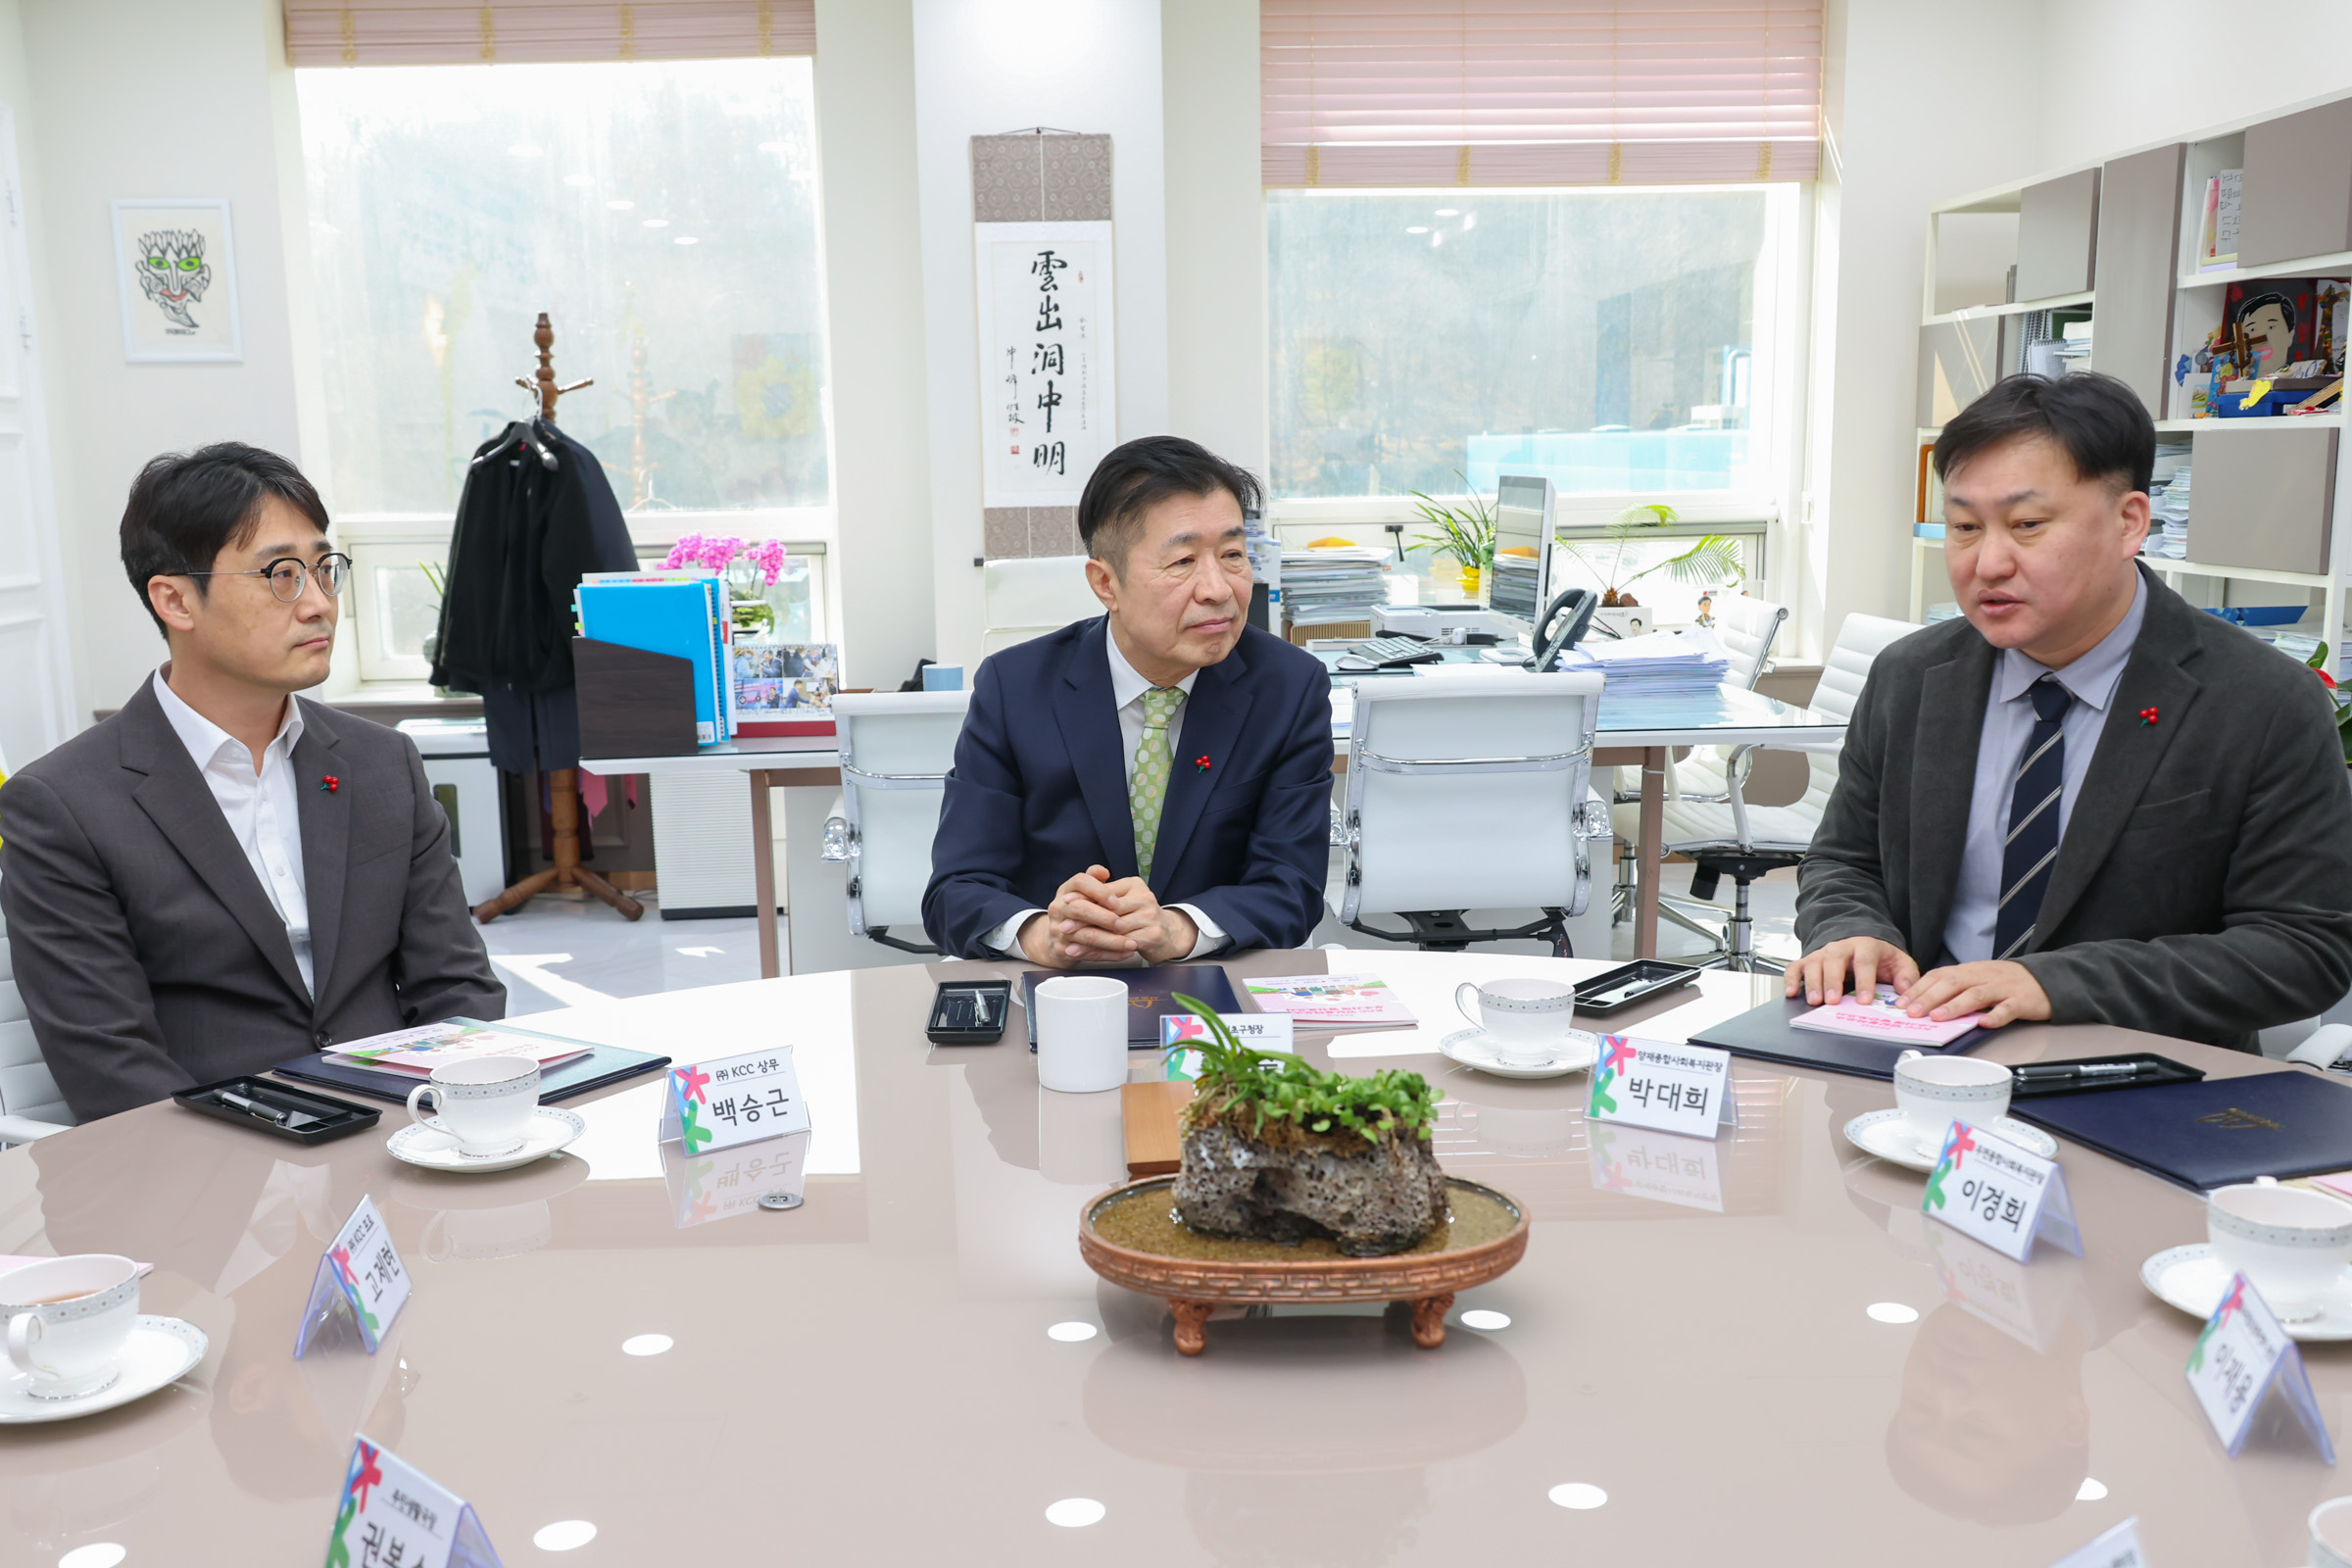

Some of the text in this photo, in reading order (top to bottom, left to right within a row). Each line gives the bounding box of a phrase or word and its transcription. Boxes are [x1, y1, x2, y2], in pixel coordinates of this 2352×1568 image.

[1031, 250, 1067, 476] 雲出洞中明
[731, 1063, 755, 1078] KCC
[758, 1058, 780, 1074] 상무
[1638, 1051, 1724, 1073] 양재종합사회복지관장
[711, 1088, 790, 1127] 백승근
[1629, 1077, 1709, 1116] 박대희
[1962, 1179, 2028, 1234] 이경희
[354, 1225, 366, 1245] KCC
[365, 1240, 400, 1303] 고제현
